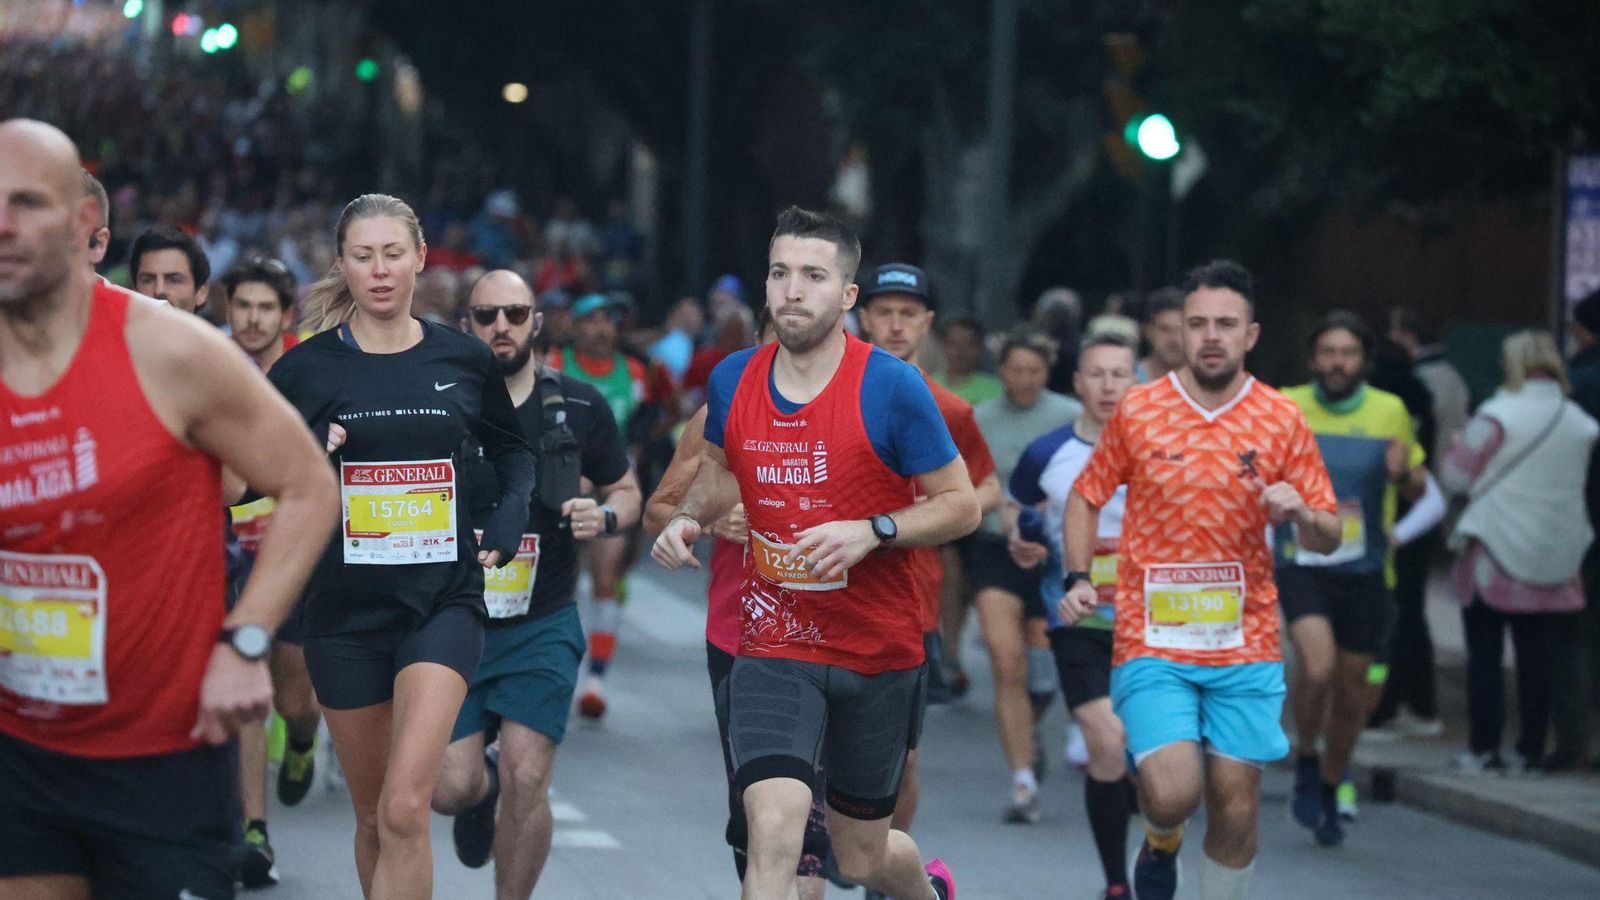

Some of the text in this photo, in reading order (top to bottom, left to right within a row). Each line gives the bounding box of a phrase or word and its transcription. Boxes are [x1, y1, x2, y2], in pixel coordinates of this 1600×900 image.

[773, 418, 799, 427] luanvi
[757, 441, 809, 453] GENERALI
[374, 465, 447, 482] GENERALI
[756, 463, 812, 485] MÁLAGA
[368, 499, 433, 519] 15764
[422, 538, 440, 546] 21K
[0, 562, 90, 587] ENERALI
[776, 570, 808, 579] ALFREDO
[1171, 567, 1236, 583] GENERALI
[1167, 595, 1224, 611] 13190
